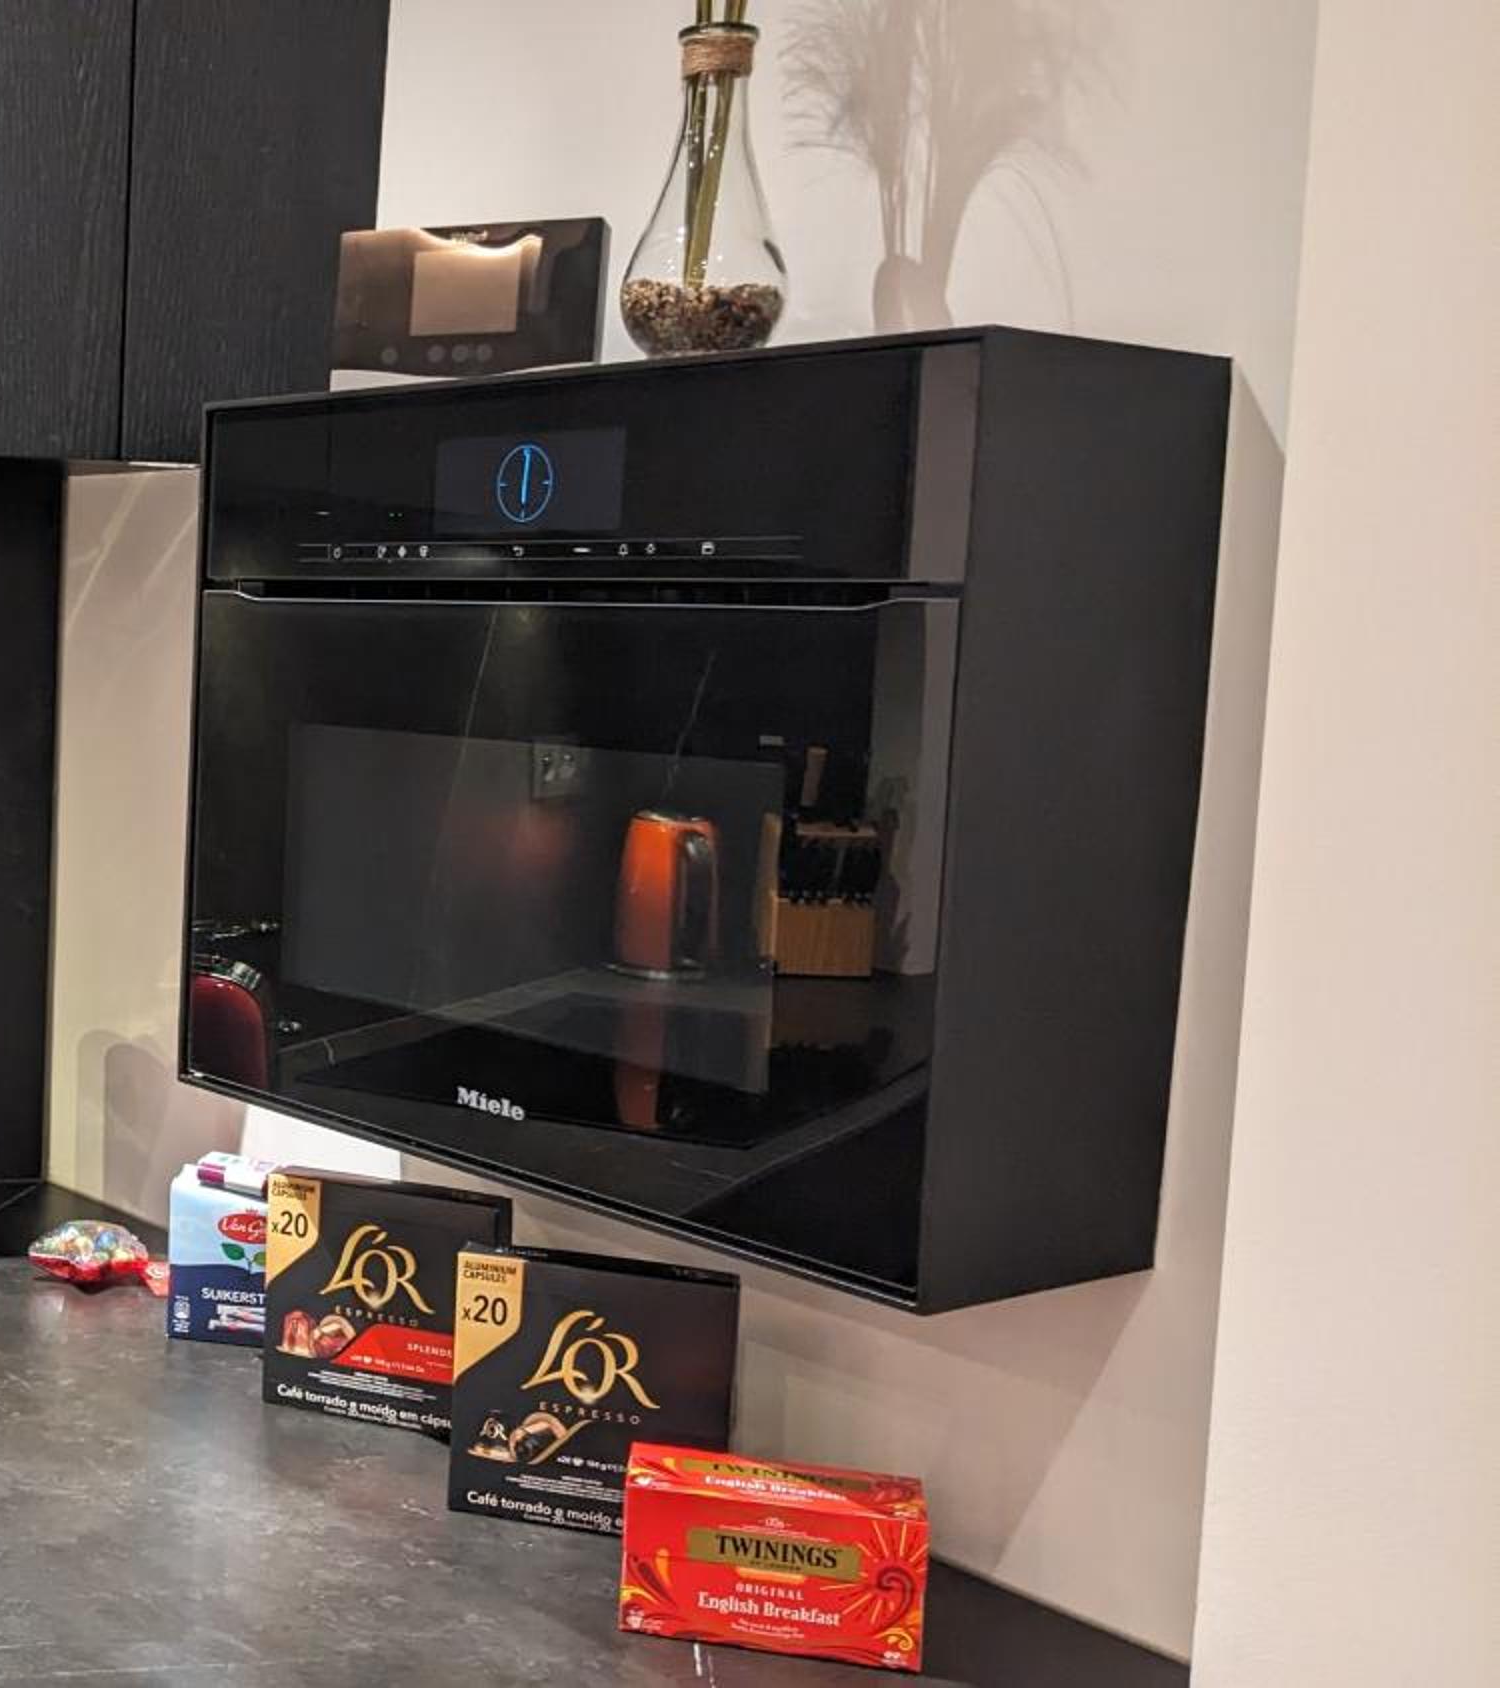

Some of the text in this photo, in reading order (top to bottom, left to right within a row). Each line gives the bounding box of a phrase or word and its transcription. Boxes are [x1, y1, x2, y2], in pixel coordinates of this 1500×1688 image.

[456, 1085, 525, 1121] Miele
[221, 1216, 266, 1241] Van G
[270, 1209, 309, 1239] x20
[463, 1260, 517, 1275] ALUMINIUM
[463, 1270, 508, 1284] CAPSULES
[334, 1304, 419, 1327] ESPRESSO
[462, 1294, 508, 1326] x20
[276, 1383, 303, 1400] Café
[305, 1390, 347, 1408] torrado
[350, 1401, 357, 1410] e
[359, 1403, 398, 1418] moído
[399, 1410, 419, 1422] em
[539, 1401, 641, 1426] ESPRESSO
[705, 1475, 767, 1492] English
[466, 1490, 499, 1507] Café
[501, 1497, 551, 1516] torrado
[554, 1508, 563, 1517] e
[566, 1508, 611, 1525] moído
[715, 1533, 838, 1568] TWININGS
[735, 1583, 804, 1601] ORIGINAL
[697, 1591, 840, 1626] English Breakfast
